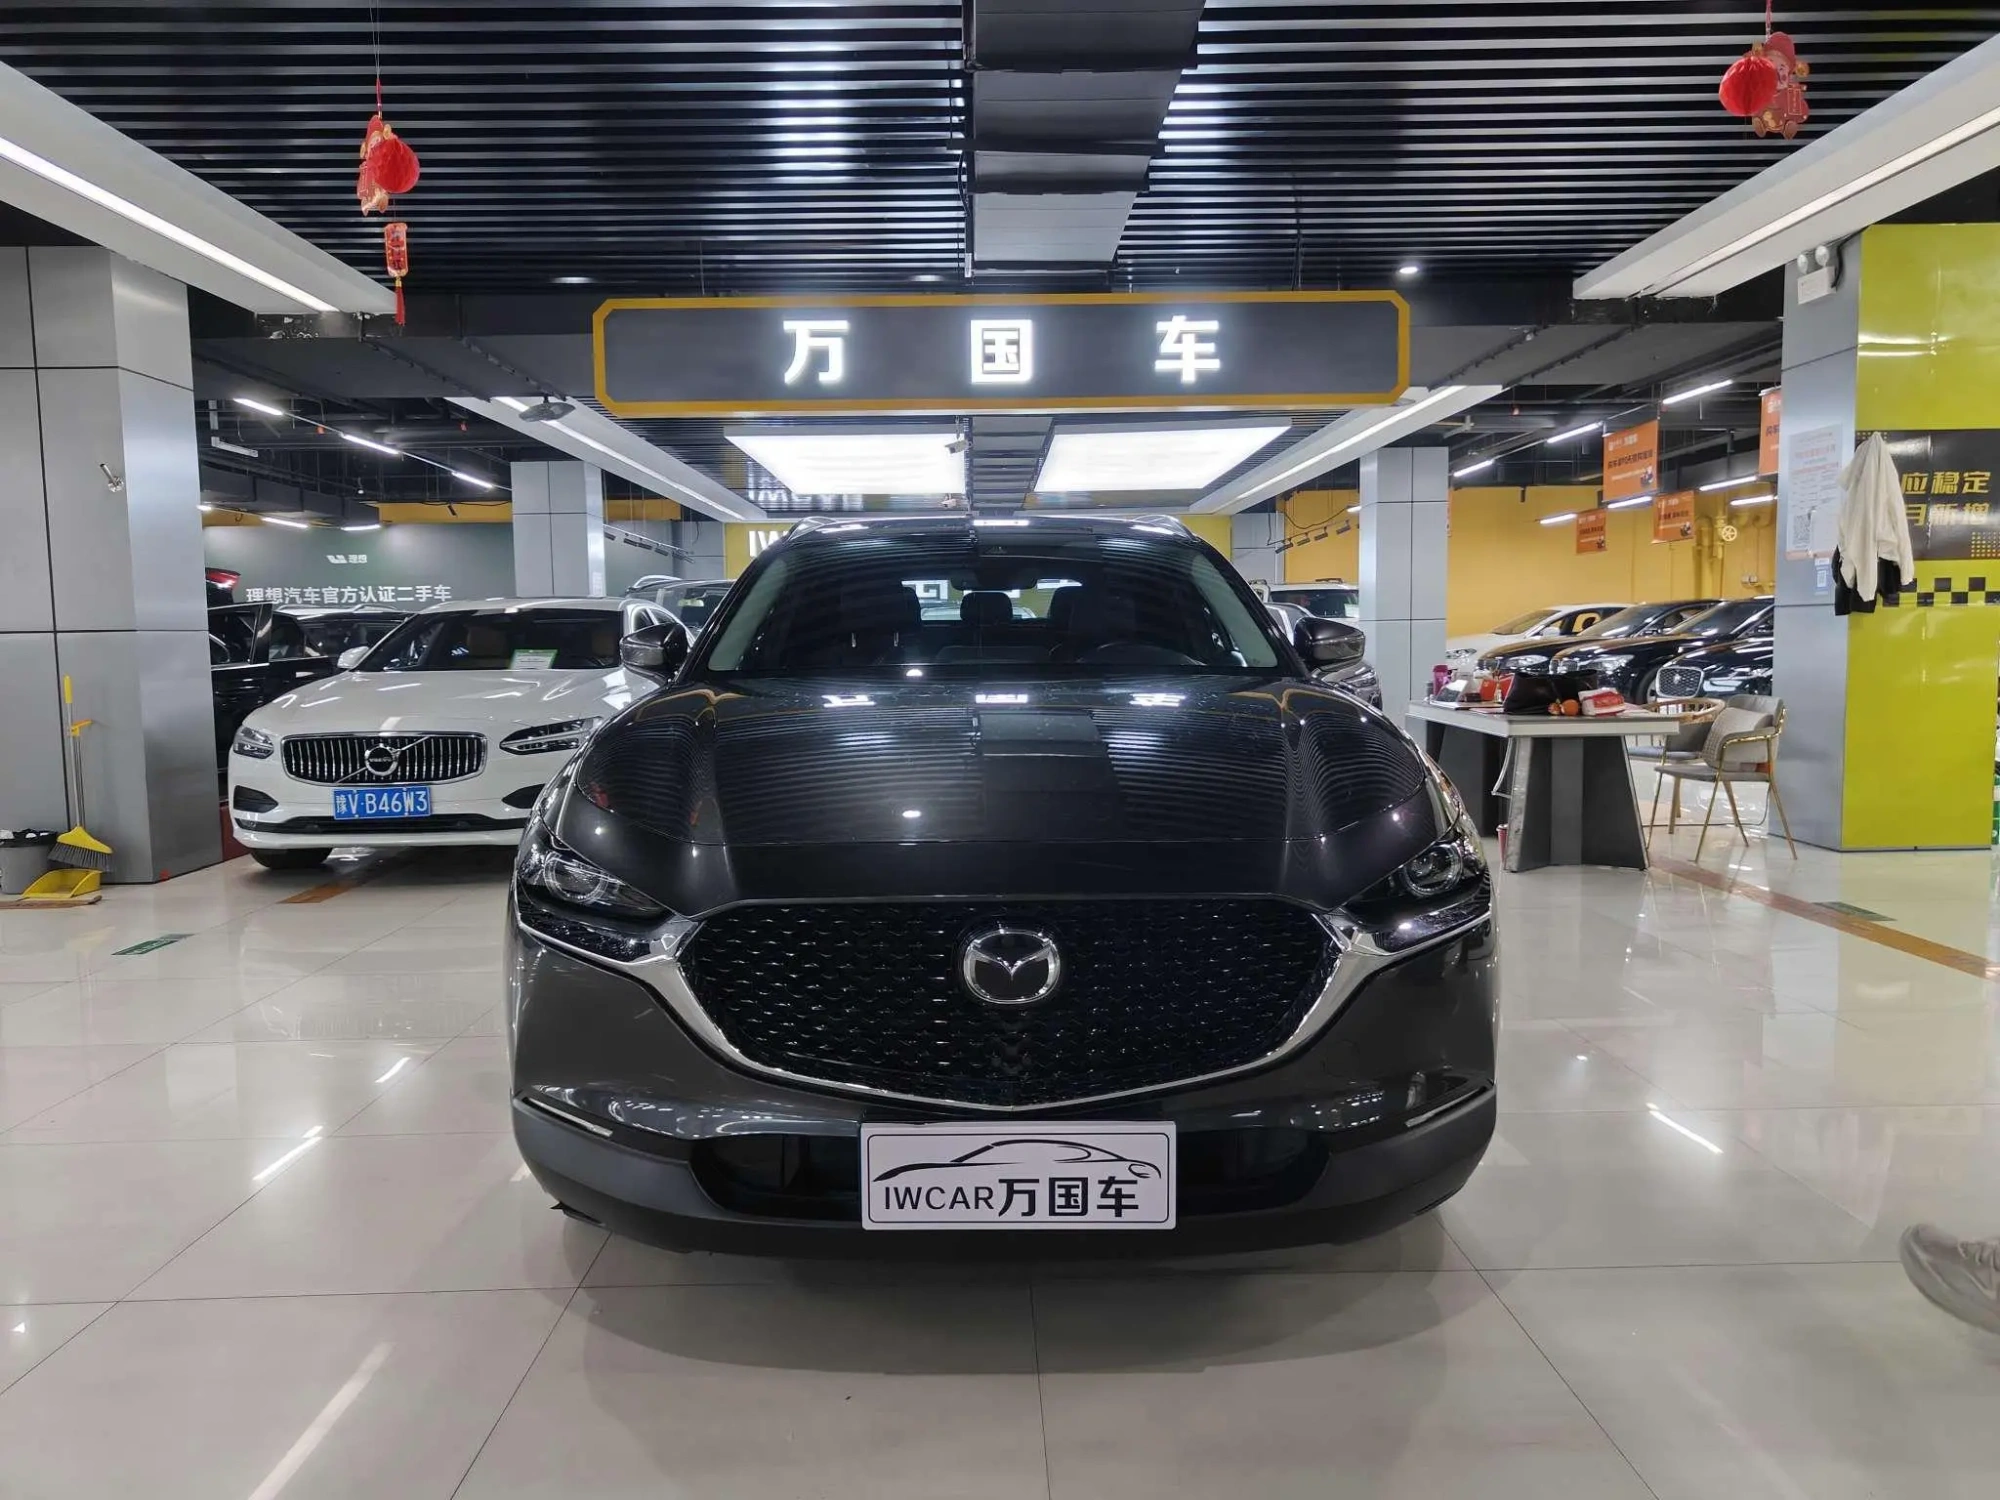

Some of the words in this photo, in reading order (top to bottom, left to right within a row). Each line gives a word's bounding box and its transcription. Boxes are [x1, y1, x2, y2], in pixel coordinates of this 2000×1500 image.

[1902, 471, 1991, 494] 应稳定
[246, 585, 452, 604] 理想汽车官方认证二手车
